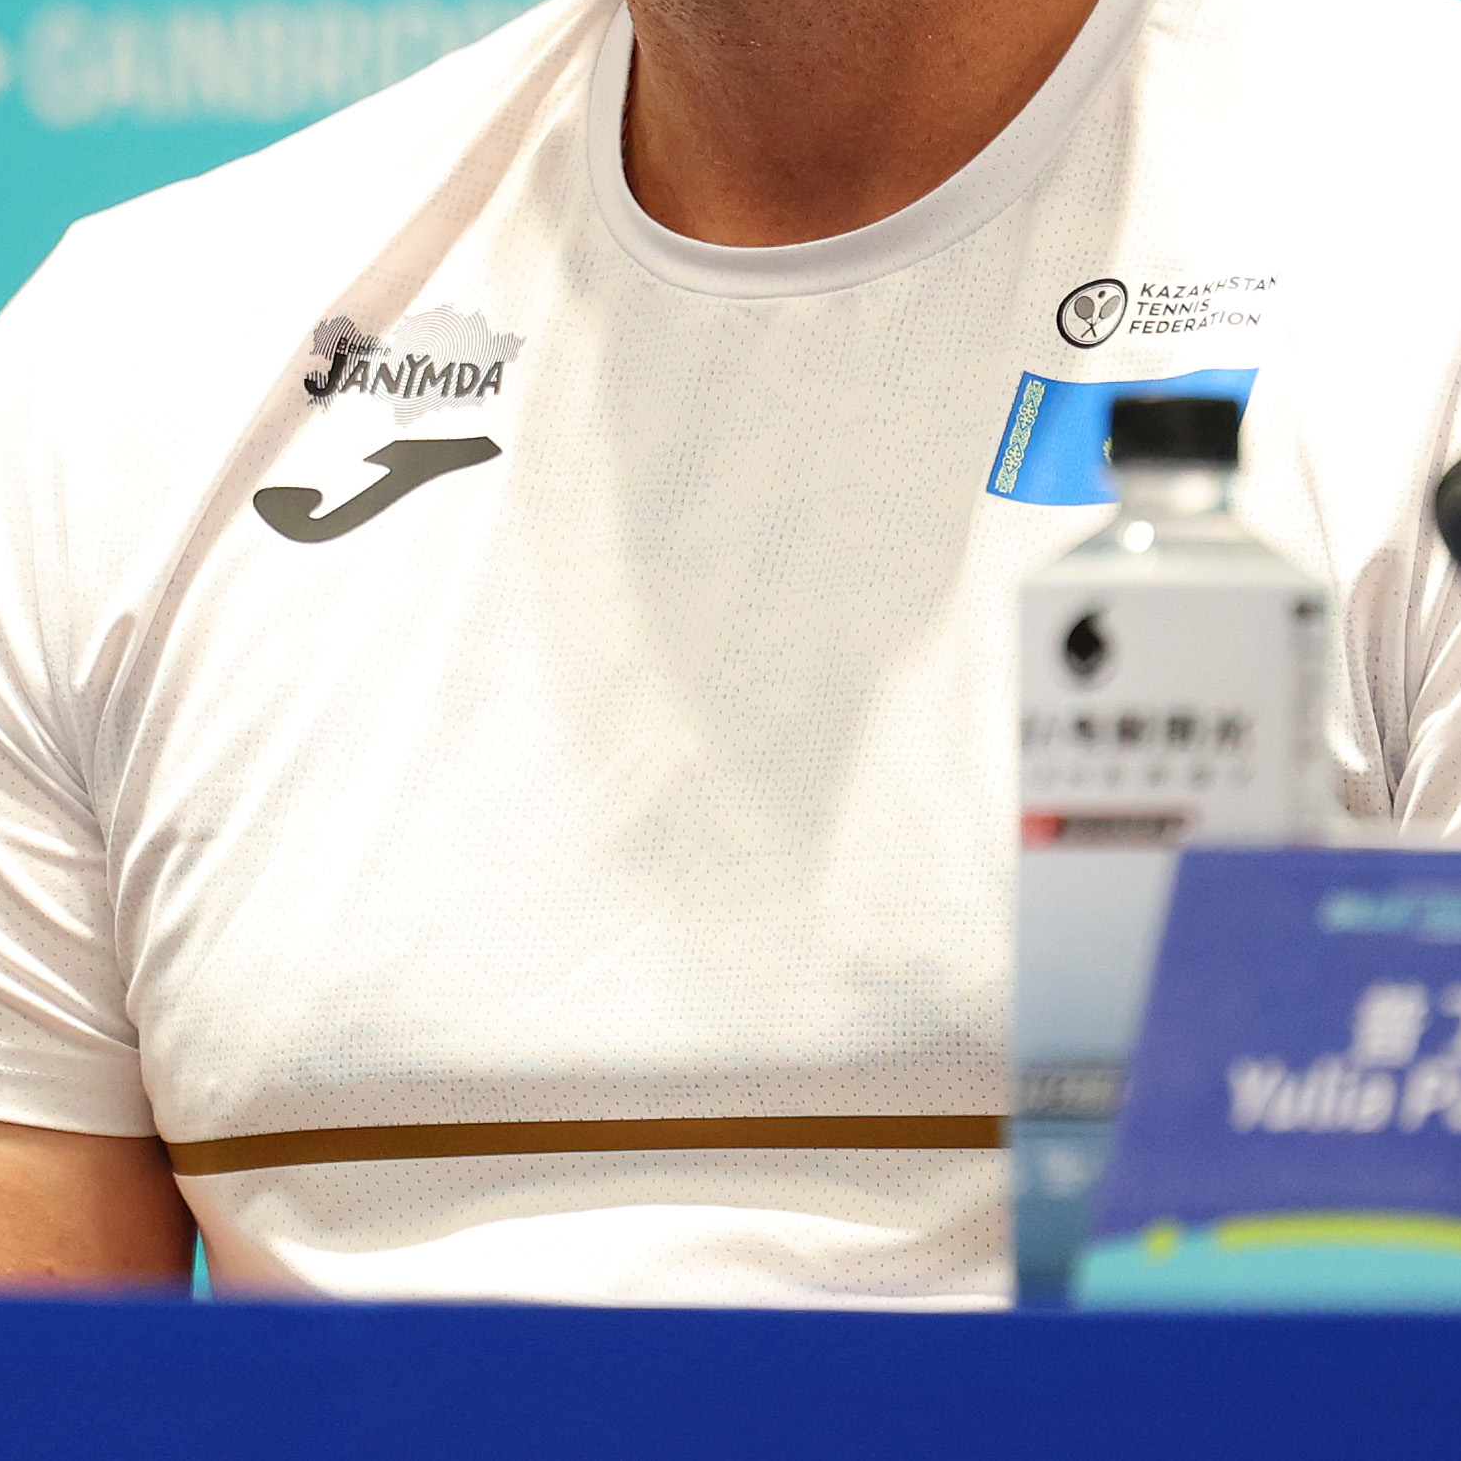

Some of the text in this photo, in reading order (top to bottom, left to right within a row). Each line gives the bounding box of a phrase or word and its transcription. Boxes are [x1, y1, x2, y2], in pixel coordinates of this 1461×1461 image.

[1140, 273, 1279, 299] KAZAKHSTAN
[1137, 298, 1211, 316] TENNIS
[1129, 310, 1261, 334] FEDERATION
[303, 351, 507, 400] JANYMDA
[1229, 1055, 1399, 1134] Yulia
